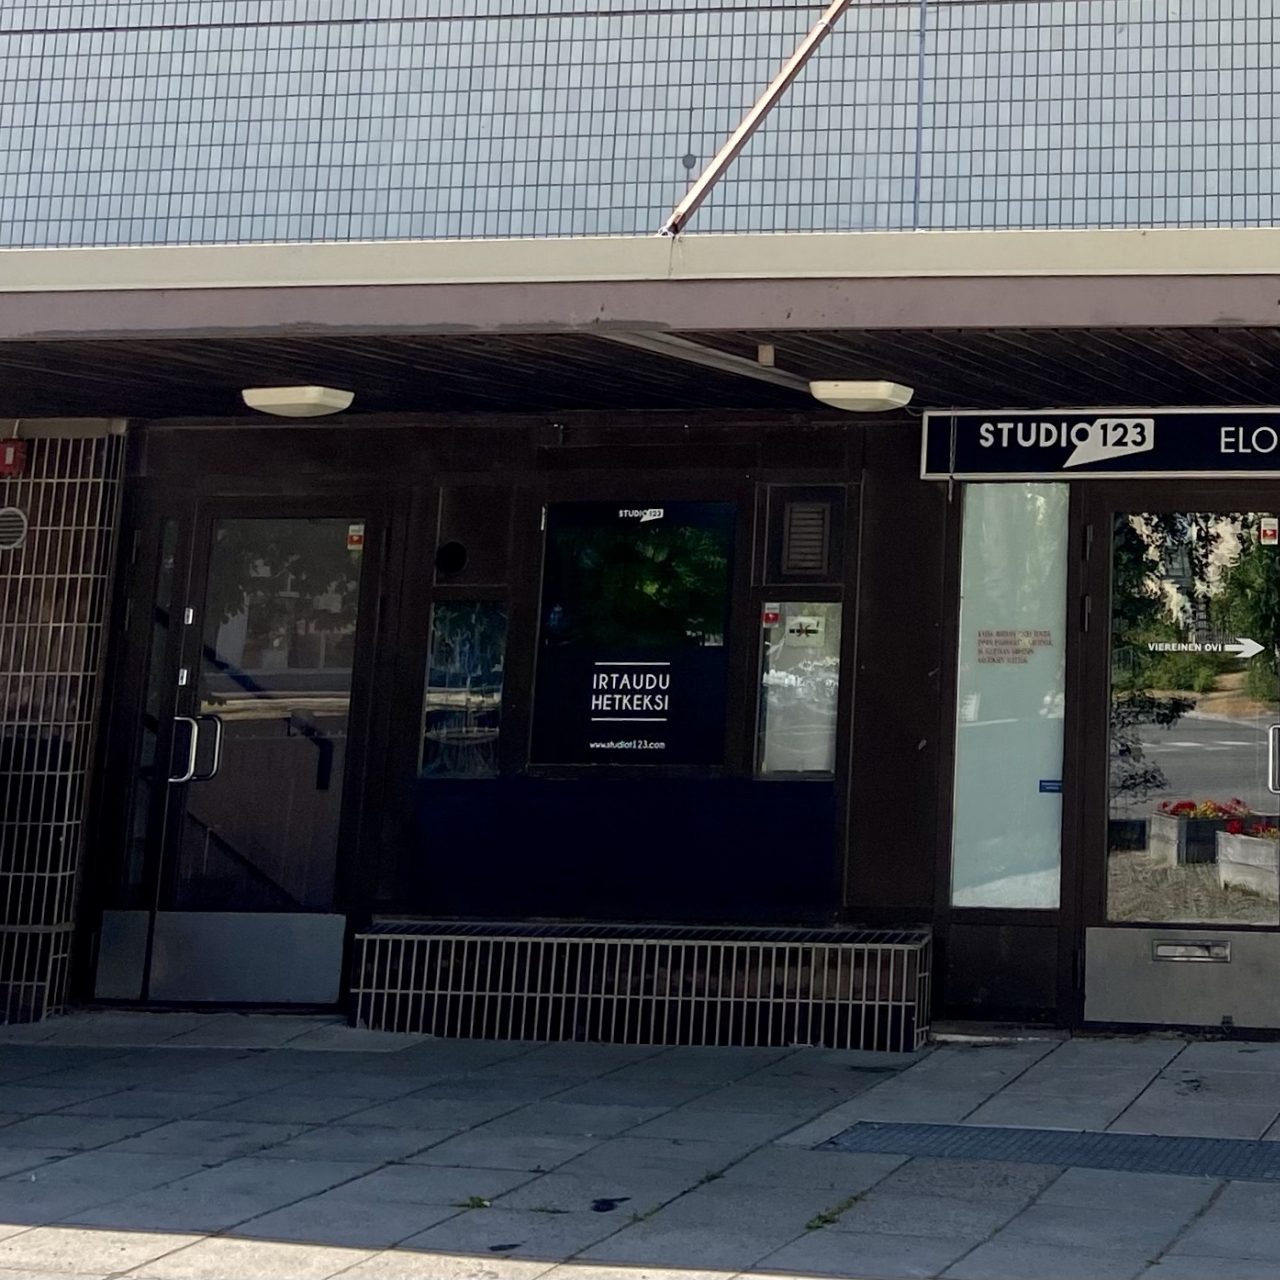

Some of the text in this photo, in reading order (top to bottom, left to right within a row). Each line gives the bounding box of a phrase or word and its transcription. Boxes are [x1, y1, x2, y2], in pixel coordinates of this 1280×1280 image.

[979, 422, 1091, 447] STUDIO
[1147, 643, 1222, 652] VIEREINEN OVI
[592, 673, 670, 690] IRTAUDU
[591, 694, 669, 711] HETKEKSI
